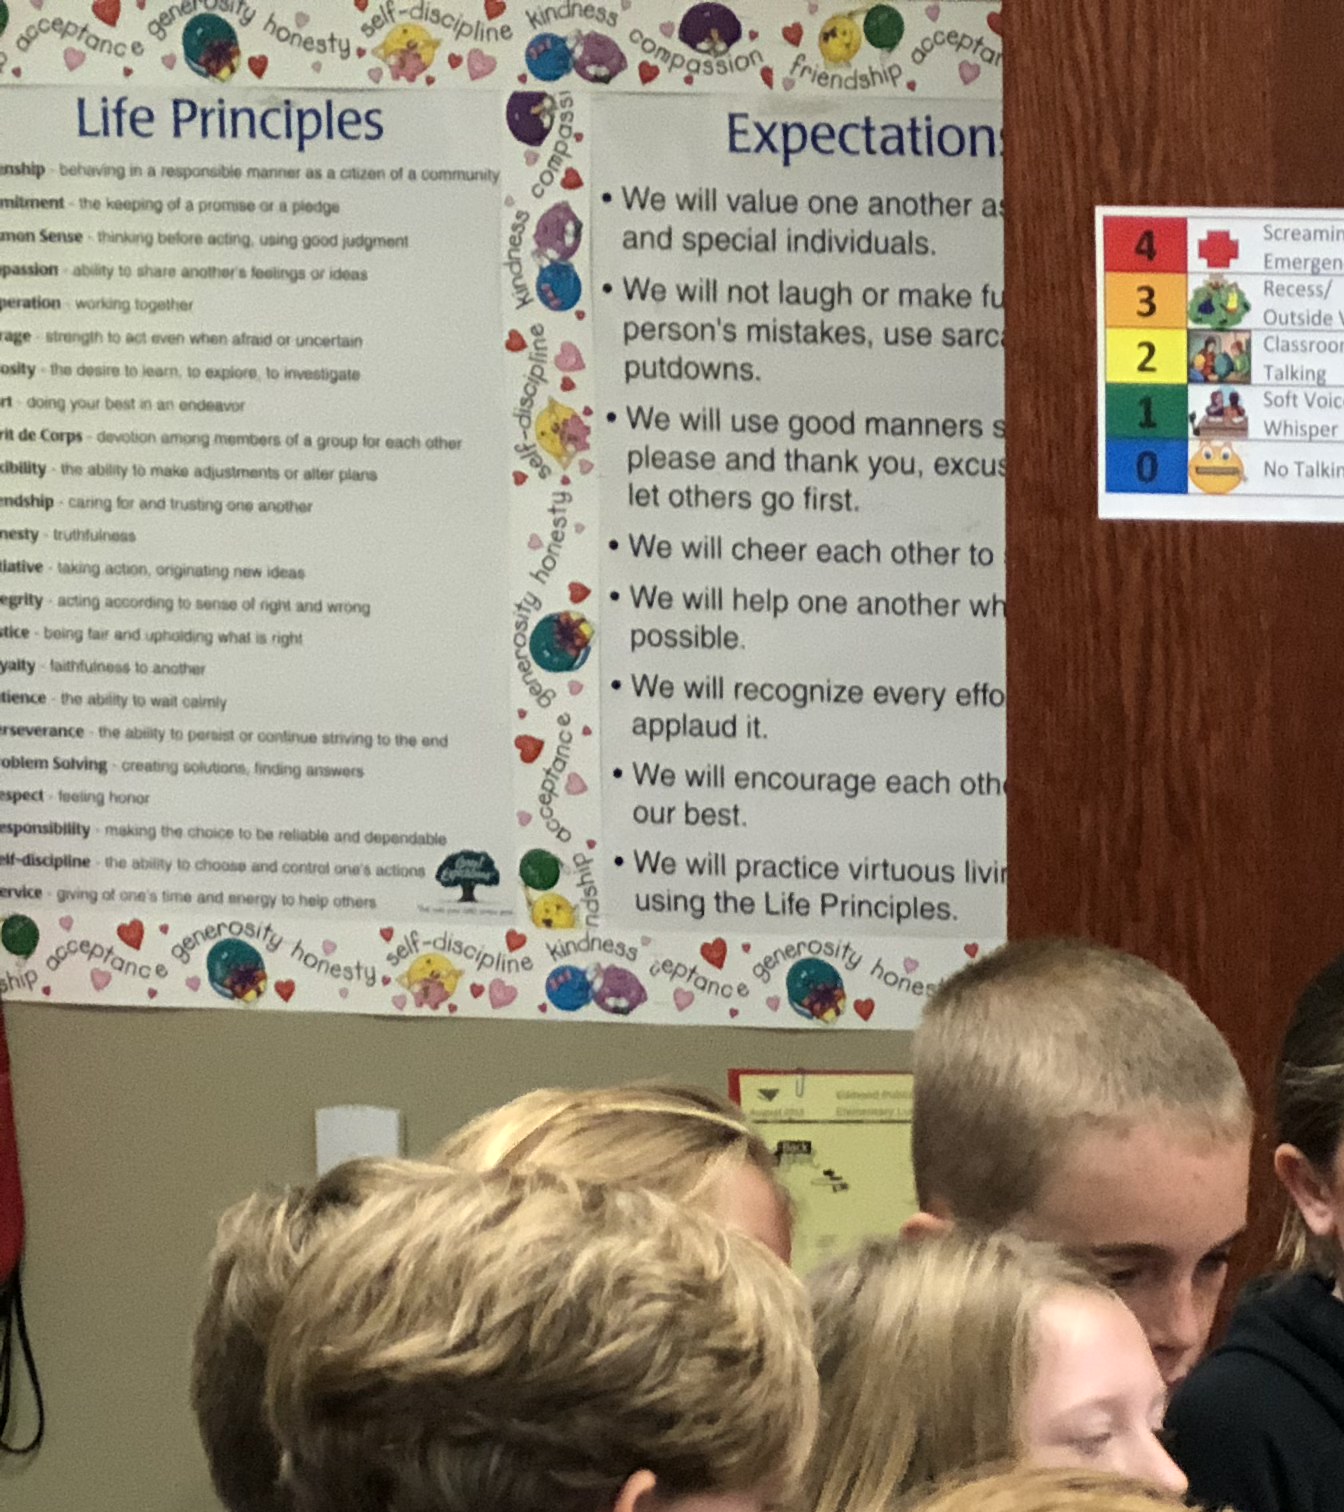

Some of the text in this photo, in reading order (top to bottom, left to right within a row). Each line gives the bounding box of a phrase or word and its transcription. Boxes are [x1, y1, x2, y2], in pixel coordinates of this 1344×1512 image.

[16, 17, 144, 57] acceptance
[147, 0, 257, 41] generosity
[263, 12, 350, 60] honesty
[361, 0, 513, 41] self-discipline
[525, 0, 619, 29] kindness
[628, 28, 764, 77] compassion
[789, 53, 902, 91] friendship
[77, 98, 385, 152] Life Principles
[727, 112, 1004, 167] Expectation
[621, 185, 973, 218] We will value one another
[0, 227, 409, 253] mon Sense thinking before acting, using good judgment
[622, 224, 936, 258] and special individuals.
[1134, 230, 1157, 261] 4
[503, 209, 534, 310] kindness
[622, 275, 667, 305] We
[675, 277, 718, 304] will
[727, 280, 770, 305] not
[778, 279, 853, 313] laugh
[861, 286, 890, 308] or
[898, 282, 973, 310] make
[1135, 285, 1157, 318] 3
[1263, 279, 1334, 300] Recess/
[623, 316, 933, 349] person's mistakes, use
[1263, 309, 1333, 327] Outside
[624, 355, 761, 385] putdowns.
[1136, 341, 1157, 373] 2
[1263, 364, 1327, 384] Talking
[513, 322, 552, 480] self-discipline
[1138, 396, 1157, 429] 1
[1263, 390, 1299, 408] Soft
[625, 404, 984, 442] We will use good manners
[1263, 420, 1339, 439] Whisper
[627, 444, 717, 476] please
[725, 446, 776, 473] and
[783, 447, 860, 474] thank
[867, 455, 924, 482] you,
[1135, 450, 1158, 484] 0
[1264, 461, 1290, 479] No
[628, 481, 860, 518] let others go first.
[529, 492, 573, 585] honesty
[628, 532, 994, 567] We will cheer each other to
[629, 584, 674, 611] We
[681, 586, 724, 612] will
[732, 586, 790, 619] help
[797, 594, 848, 615] one
[856, 591, 962, 618] another
[512, 591, 557, 708] generosity
[630, 623, 746, 654] possible.
[630, 673, 675, 700] We
[683, 675, 724, 701] will
[733, 678, 864, 710] recognize
[872, 685, 947, 713] every
[631, 712, 768, 743] applaud it.
[51, 754, 109, 777] Solving
[120, 759, 180, 777] creating
[182, 760, 250, 777] solutions,
[253, 760, 302, 781] finding
[305, 765, 366, 779] answers
[538, 712, 573, 842] acceptance
[631, 760, 951, 800] We will encourage each
[632, 800, 747, 827] our best.
[104, 823, 157, 842] making
[160, 824, 184, 840] the
[186, 825, 235, 841] choice
[238, 827, 253, 841] to
[255, 827, 275, 842] be
[277, 827, 330, 844] reliable
[332, 829, 361, 845] and
[363, 830, 448, 847] dependable
[633, 848, 956, 884] We will practice virtuous
[634, 888, 958, 926] using the Life Principles.
[46, 939, 168, 979] acceptance
[171, 920, 284, 964] generosity
[291, 938, 376, 987] honesty
[386, 931, 533, 973] self-discipline
[545, 931, 637, 962] kindness
[752, 939, 863, 984] generosity
